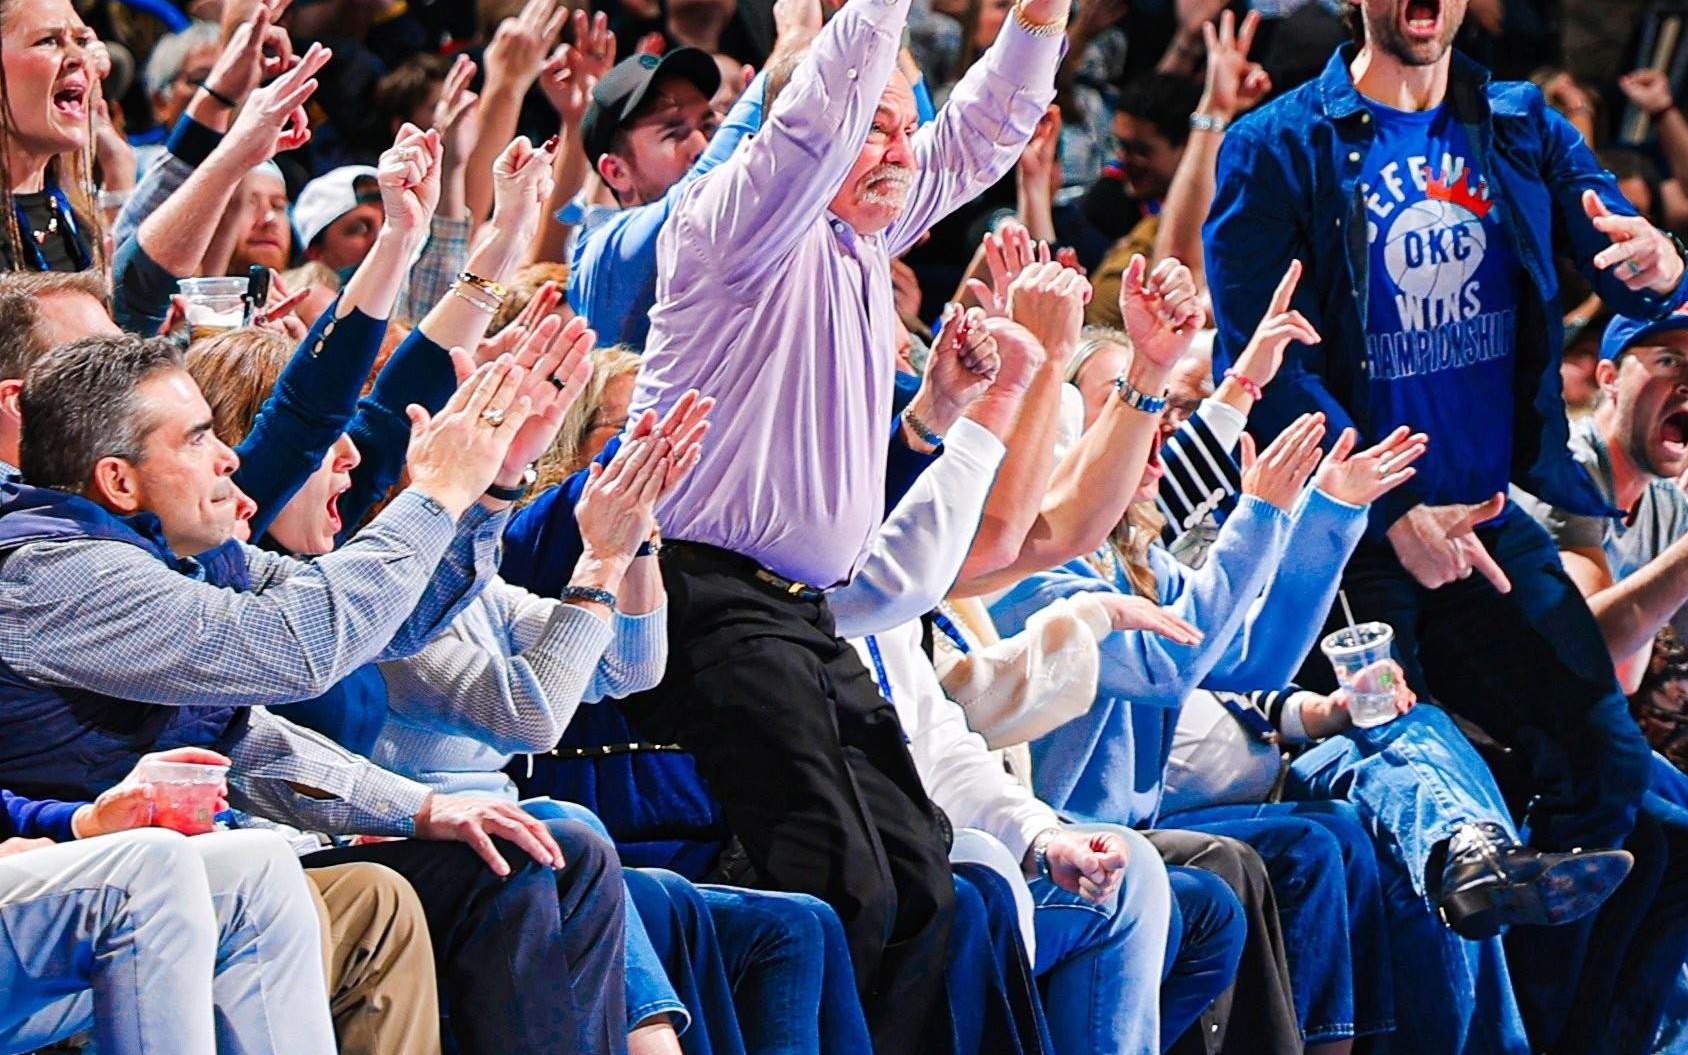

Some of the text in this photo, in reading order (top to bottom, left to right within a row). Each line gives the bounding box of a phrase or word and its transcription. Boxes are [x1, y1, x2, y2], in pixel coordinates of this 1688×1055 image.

[1405, 223, 1471, 268] OKC
[1395, 279, 1482, 332] WINS
[1366, 308, 1515, 381] HAMPIONSHIP
